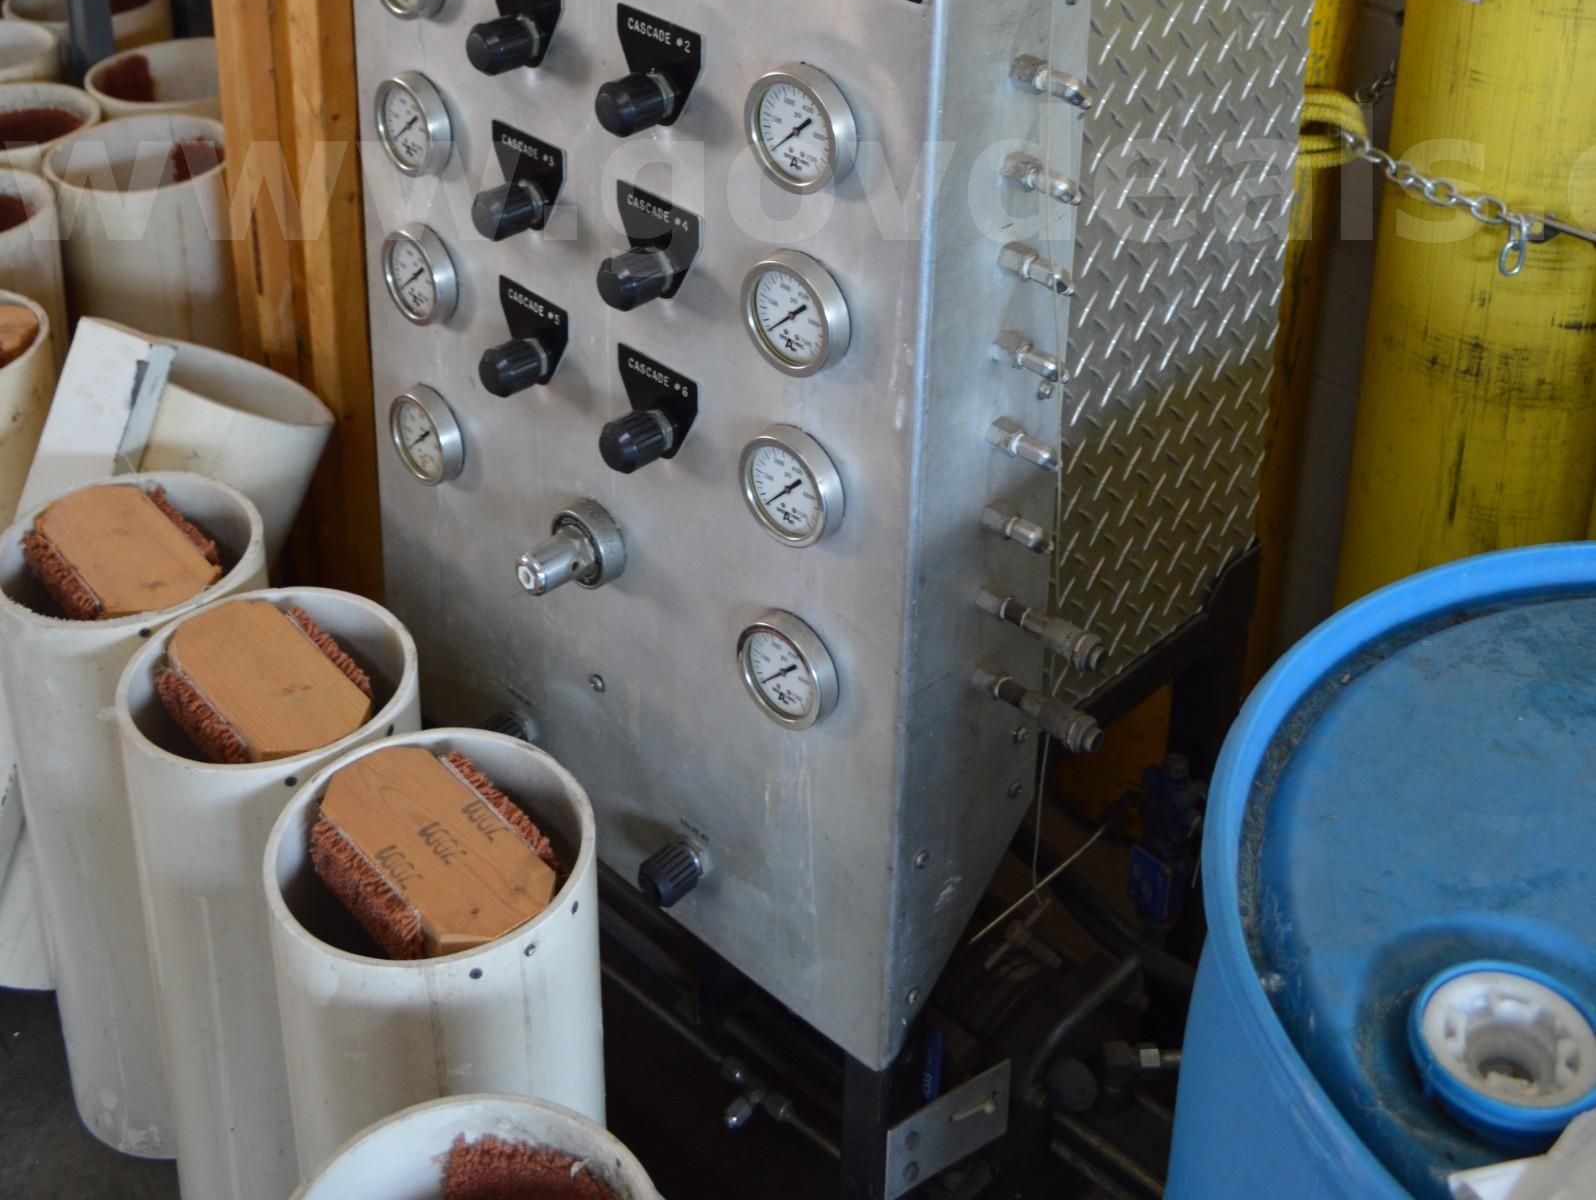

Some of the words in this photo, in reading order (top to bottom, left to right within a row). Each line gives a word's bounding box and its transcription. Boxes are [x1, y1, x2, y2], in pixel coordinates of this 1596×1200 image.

[627, 17, 671, 46] CASCADE
[676, 37, 691, 54] #2
[501, 133, 539, 160] CASCADE
[543, 154, 555, 167] #3
[626, 193, 670, 224] CASCADE
[674, 217, 689, 232] #4
[507, 288, 545, 317] CASCADE
[547, 311, 560, 326] #5
[628, 357, 670, 388] CASCADE
[673, 382, 689, 398] #6
